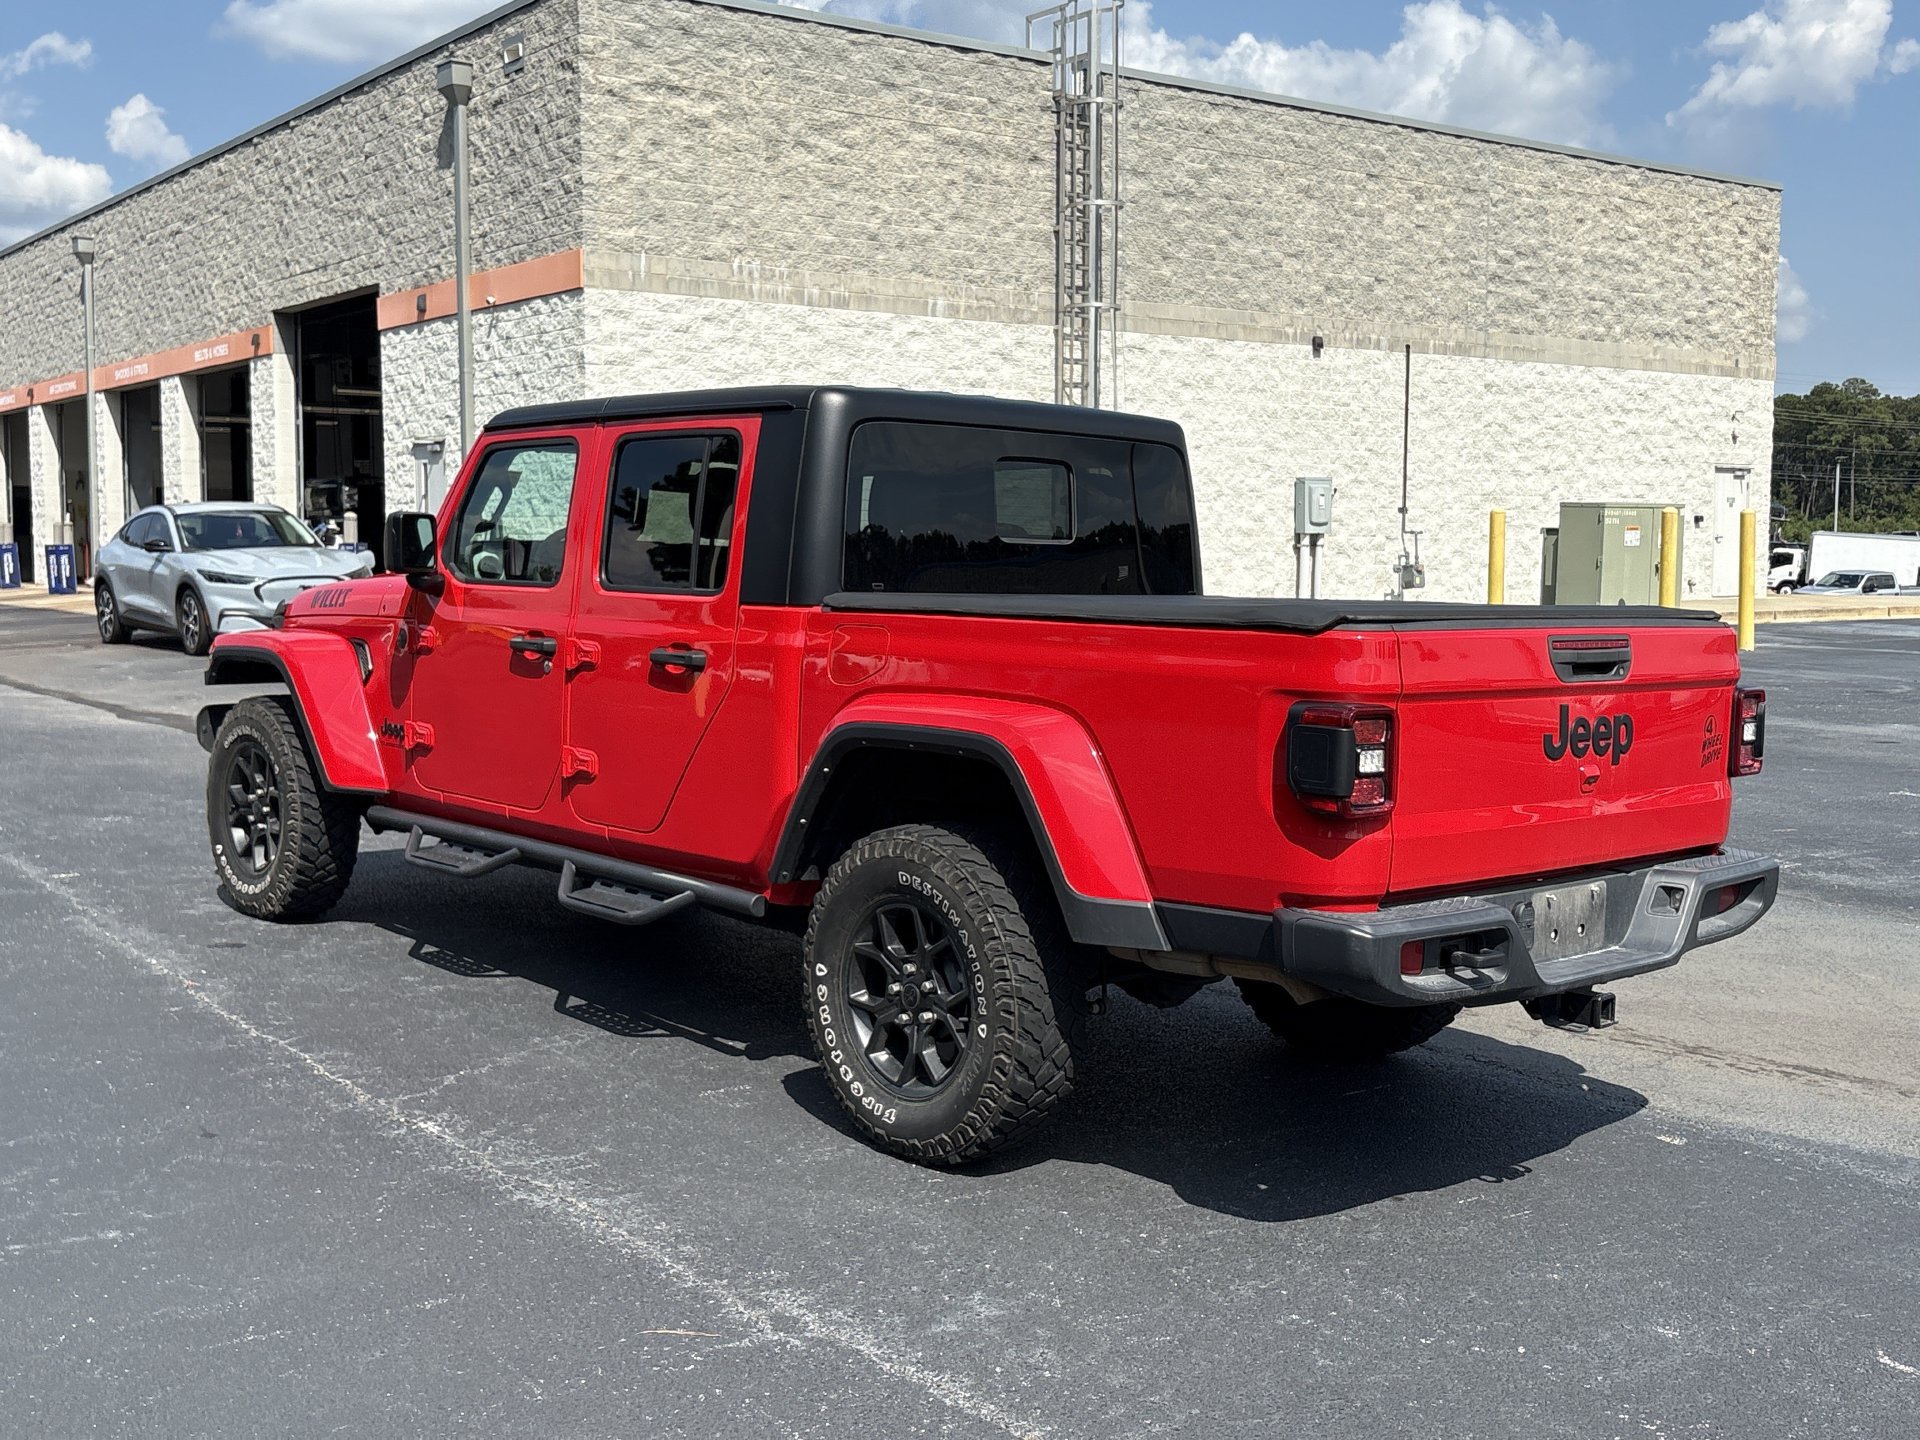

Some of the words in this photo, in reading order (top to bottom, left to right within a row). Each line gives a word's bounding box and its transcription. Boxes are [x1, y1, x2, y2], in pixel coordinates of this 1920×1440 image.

[311, 588, 353, 609] WILLYS
[380, 717, 405, 743] Jeep
[1543, 704, 1634, 766] Jeep
[1701, 733, 1723, 754] WHEEL
[1701, 746, 1722, 768] DRIVE
[898, 870, 988, 1017] DESTINATION
